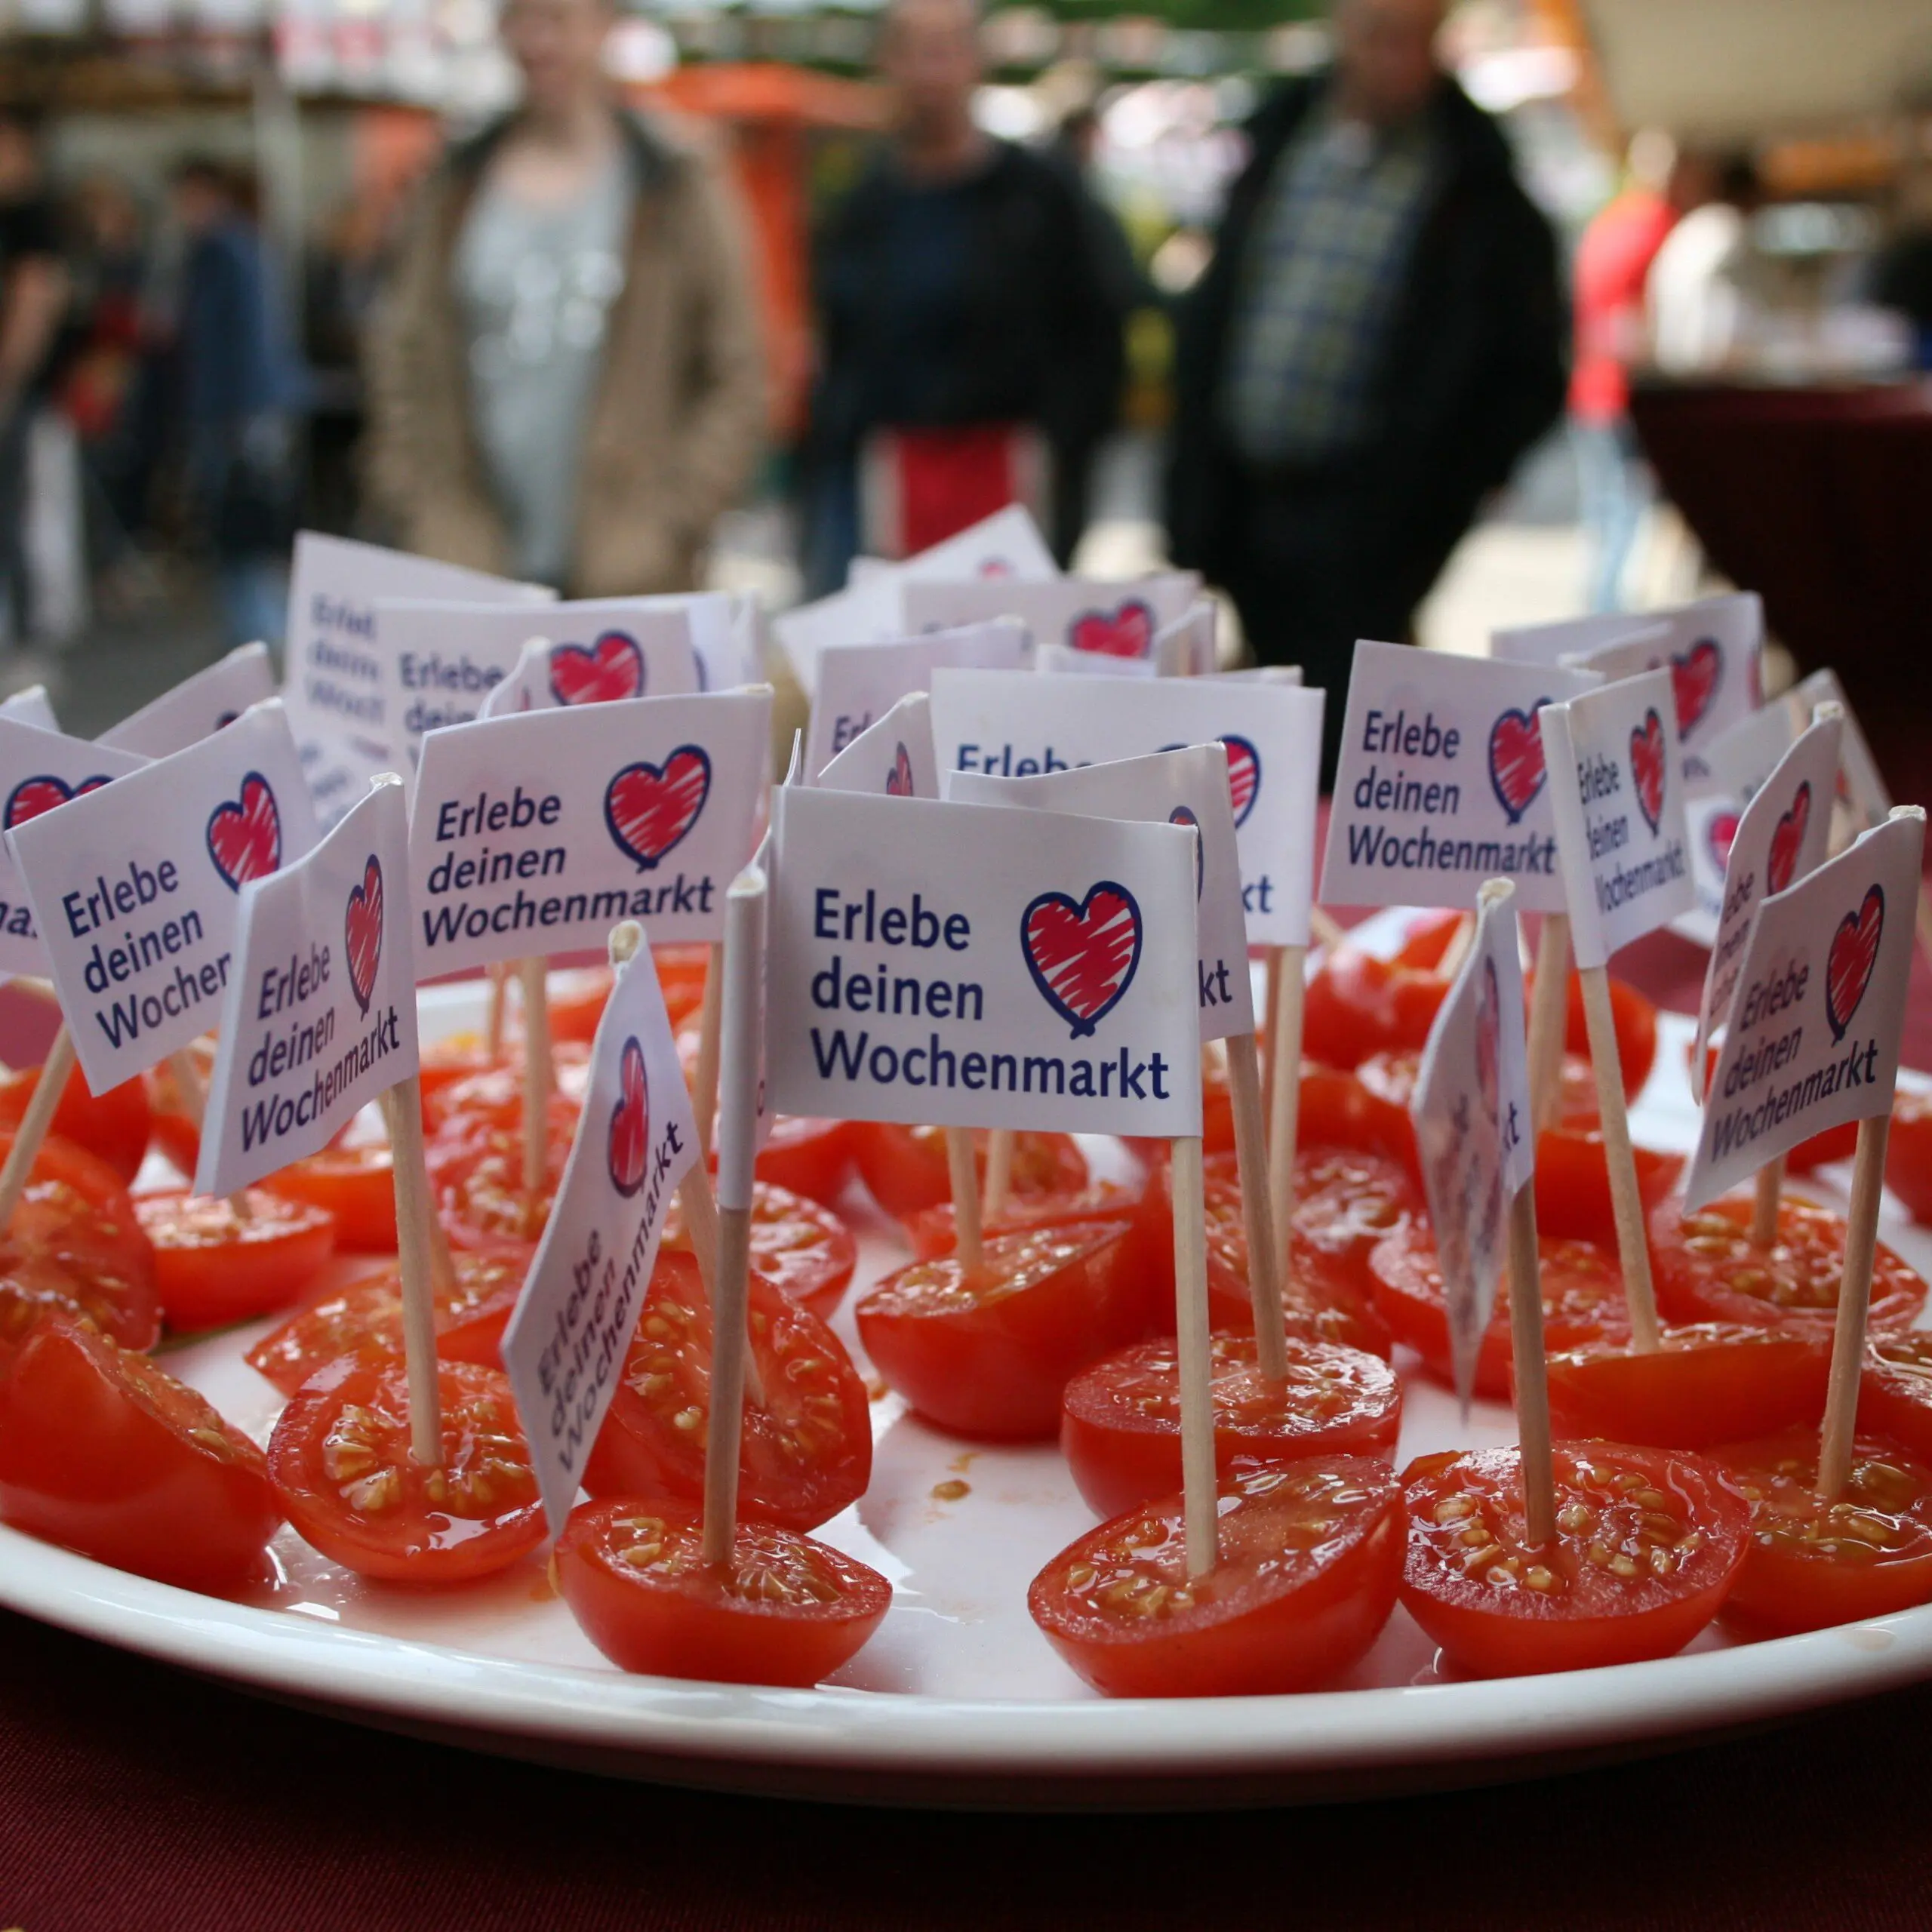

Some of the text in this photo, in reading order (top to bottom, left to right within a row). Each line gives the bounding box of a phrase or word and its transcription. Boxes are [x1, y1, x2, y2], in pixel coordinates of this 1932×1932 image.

[1363, 710, 1460, 759] Erlebe
[435, 787, 561, 842] Erlebe
[1355, 765, 1460, 815] deinen
[427, 847, 566, 894] deinen
[1349, 823, 1558, 875] Wochenmarkt
[63, 860, 179, 937] Erlebe
[423, 873, 715, 946] Wochenmarkt
[814, 888, 971, 951] Erlebe
[85, 909, 203, 994] deinen
[257, 941, 331, 1020] Erlebe
[811, 955, 984, 1020] deinen
[1740, 958, 1810, 1032] Erlebe
[241, 1005, 400, 1153] Wochenmarkt
[248, 1007, 335, 1087] deinen
[811, 1027, 1170, 1100] Wochenmarkt
[1723, 1026, 1803, 1099] deinen
[1712, 1038, 1878, 1163] Wochenmarkt
[537, 1229, 602, 1398] Erlebe
[558, 1120, 684, 1473] Wochenmarkt
[551, 1256, 617, 1437] deinen
